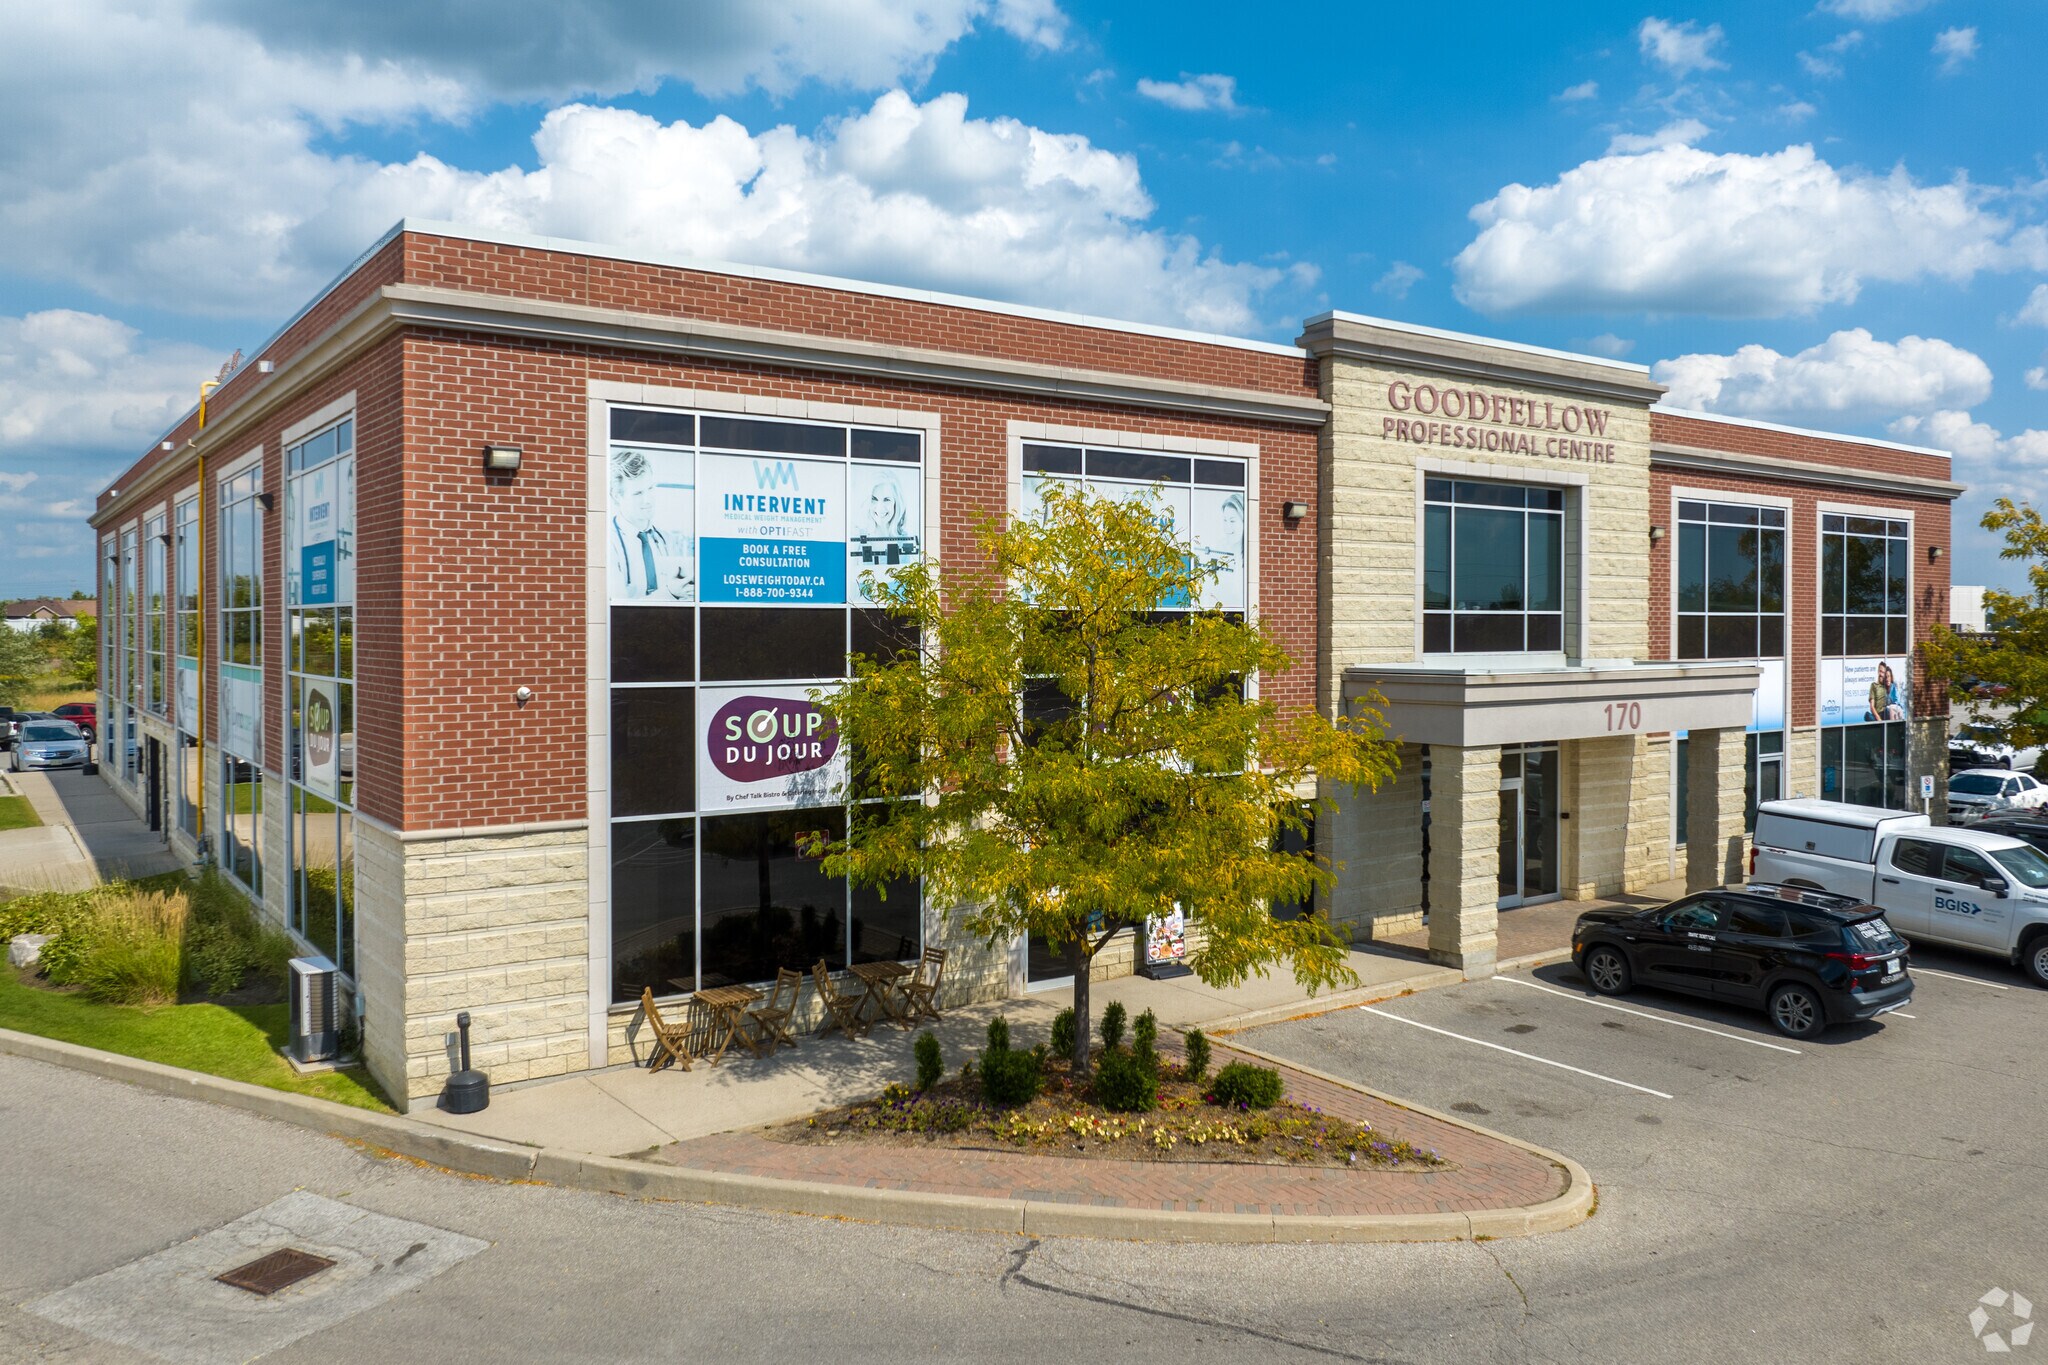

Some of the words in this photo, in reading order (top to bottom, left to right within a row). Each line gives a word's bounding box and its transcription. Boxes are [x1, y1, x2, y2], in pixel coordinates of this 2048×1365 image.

[1388, 380, 1611, 437] GOODFELLOW
[1383, 416, 1540, 455] PROFESSIONAL
[1546, 437, 1616, 463] CENTRE
[724, 494, 826, 515] INTERVENT
[724, 513, 752, 521] MEDICAL
[753, 514, 779, 522] WEIGHT
[738, 525, 757, 534] with
[743, 544, 770, 555] BOOK
[772, 545, 780, 555] A
[782, 546, 807, 556] FREE
[739, 557, 811, 568] CONSULTATION
[723, 574, 826, 586] LOSEWEIGHTODAY.CA
[735, 588, 814, 598] 1-888-700-9344
[1604, 702, 1641, 731] 170
[725, 708, 822, 744] SOUP
[726, 745, 757, 763] DU
[766, 742, 822, 765] JOUR
[735, 793, 749, 801] Chef
[763, 790, 780, 798] Bistro
[1935, 896, 1970, 914] BGIS
